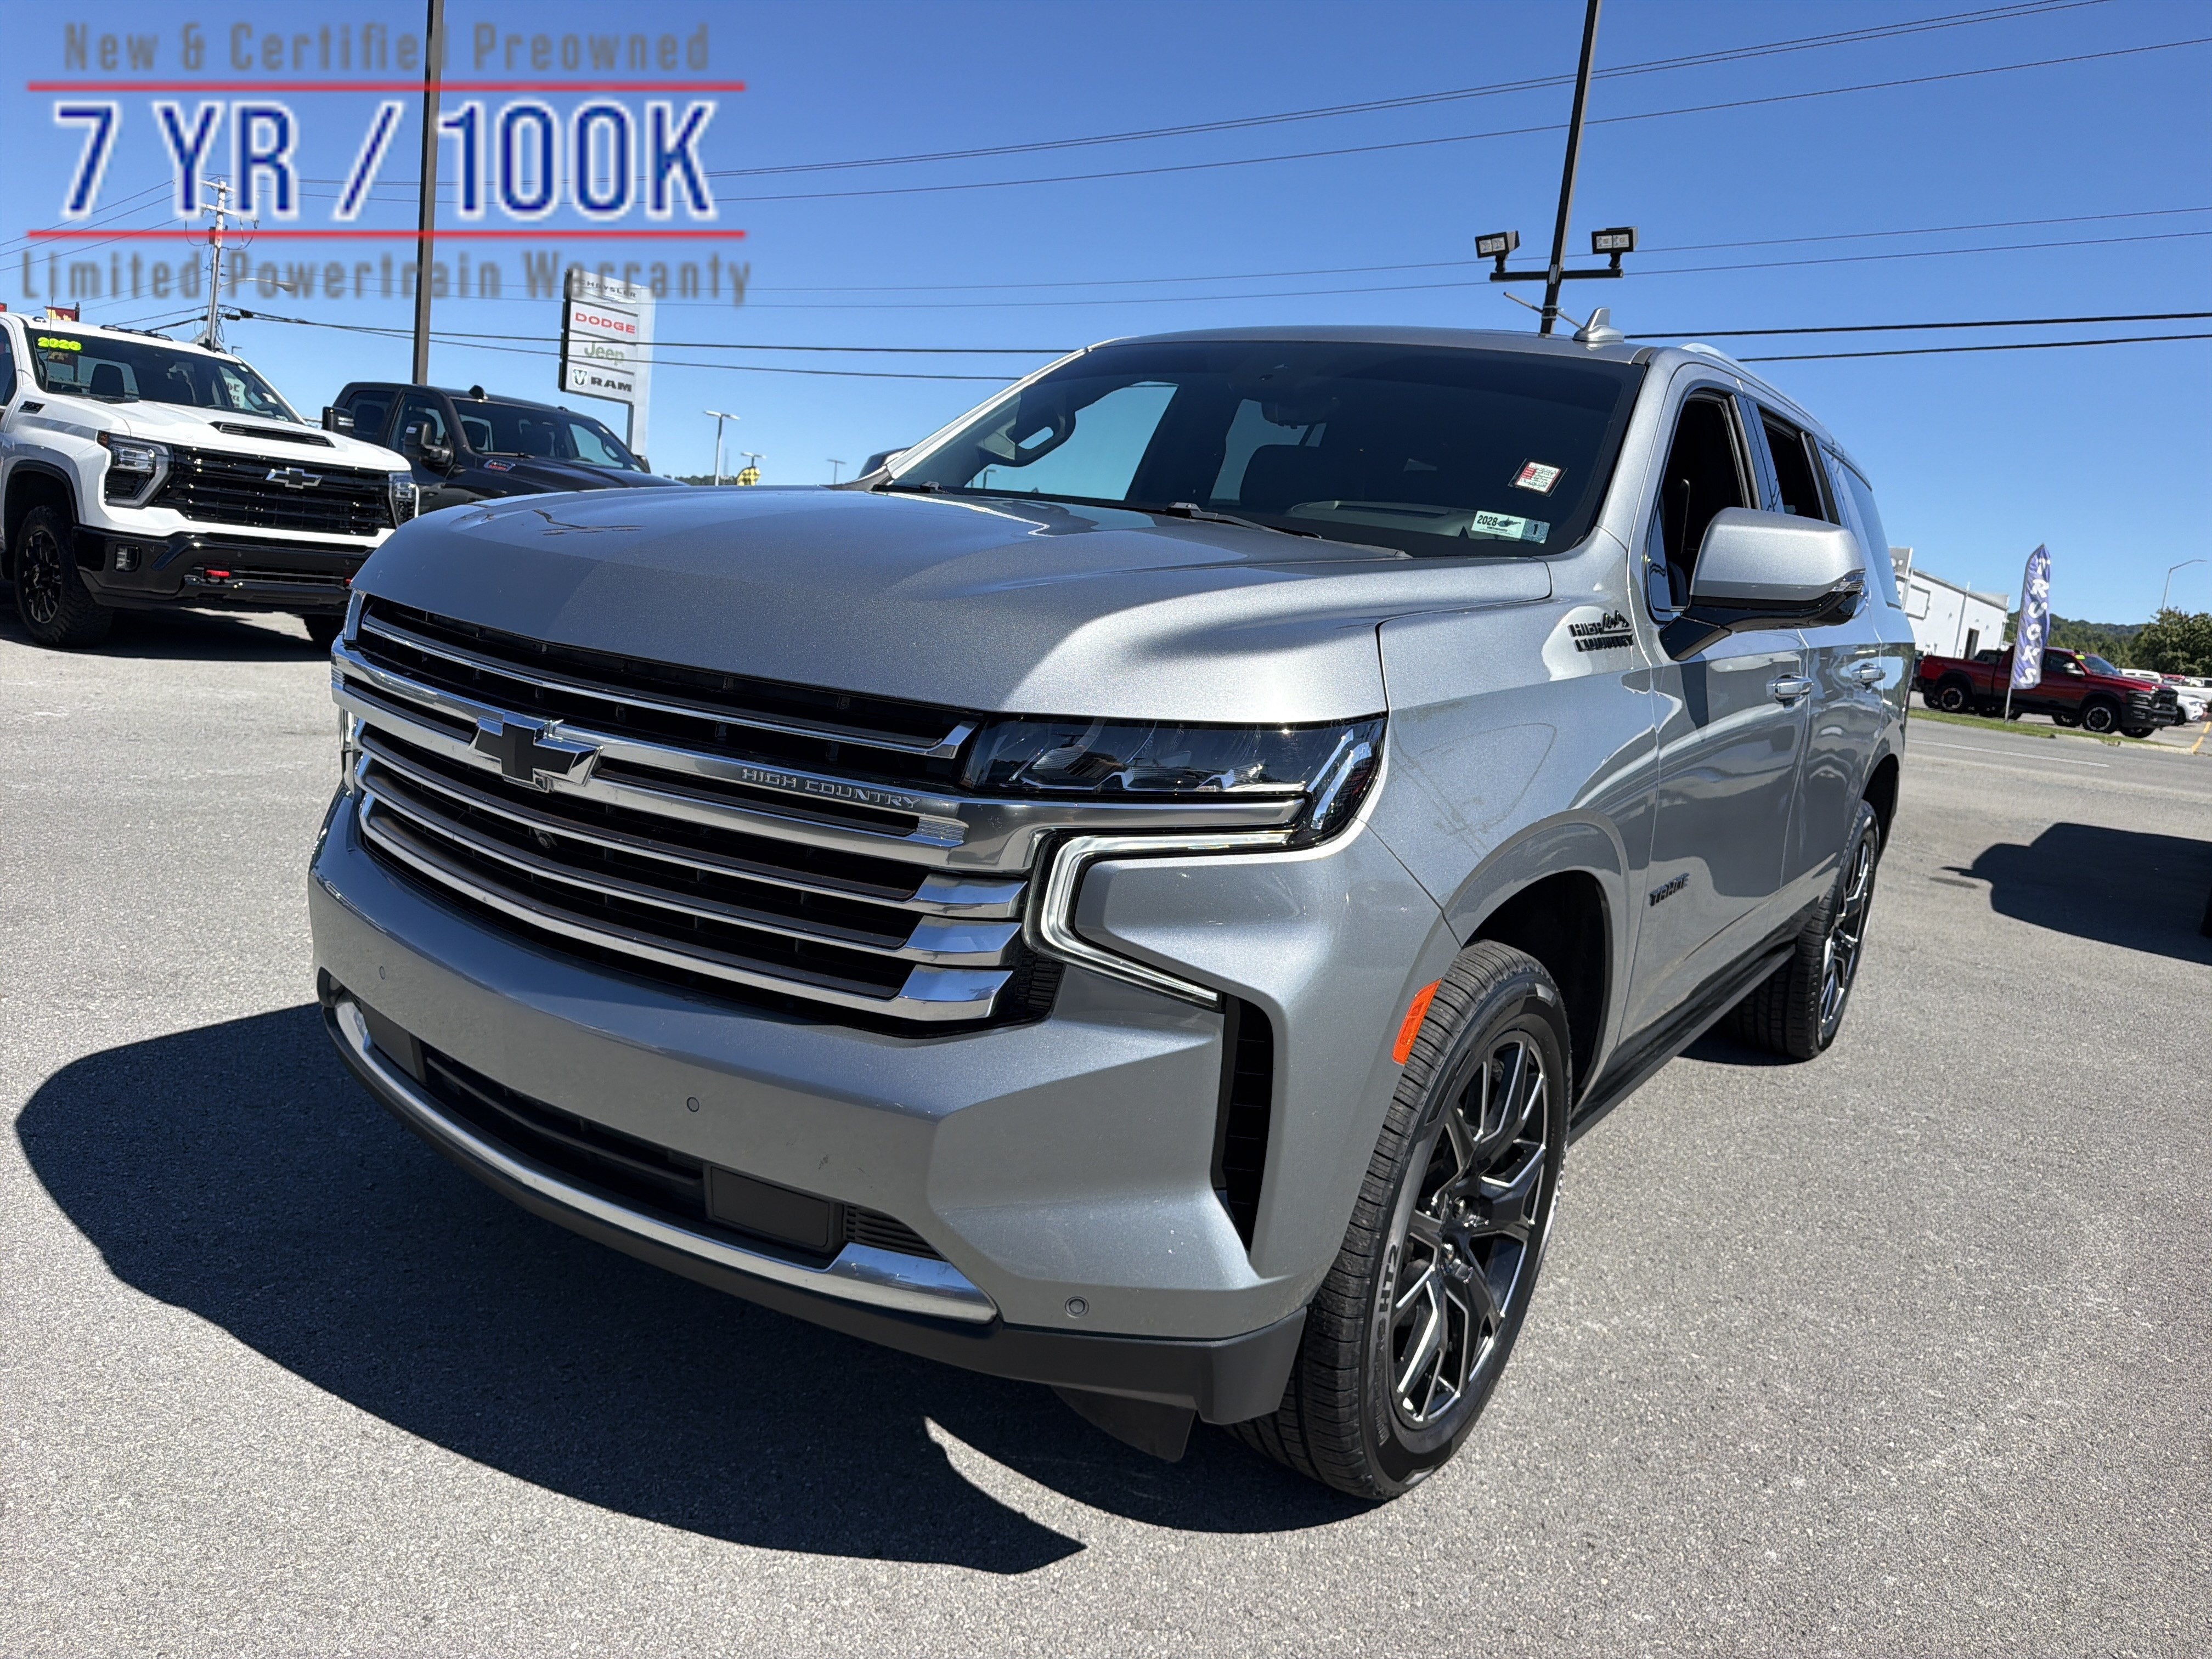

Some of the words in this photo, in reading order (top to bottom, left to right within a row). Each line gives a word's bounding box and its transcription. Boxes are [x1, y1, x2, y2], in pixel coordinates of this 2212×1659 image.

[578, 278, 636, 298] CHRYSLER
[575, 312, 636, 334] DODGE
[38, 337, 82, 351] 2026
[584, 342, 625, 365] Jeep
[590, 376, 633, 392] RAM
[1477, 515, 1498, 526] 2028
[2019, 557, 2051, 684] TRUCKS
[742, 768, 797, 788] HIGH
[804, 779, 921, 809] COUNTRY
